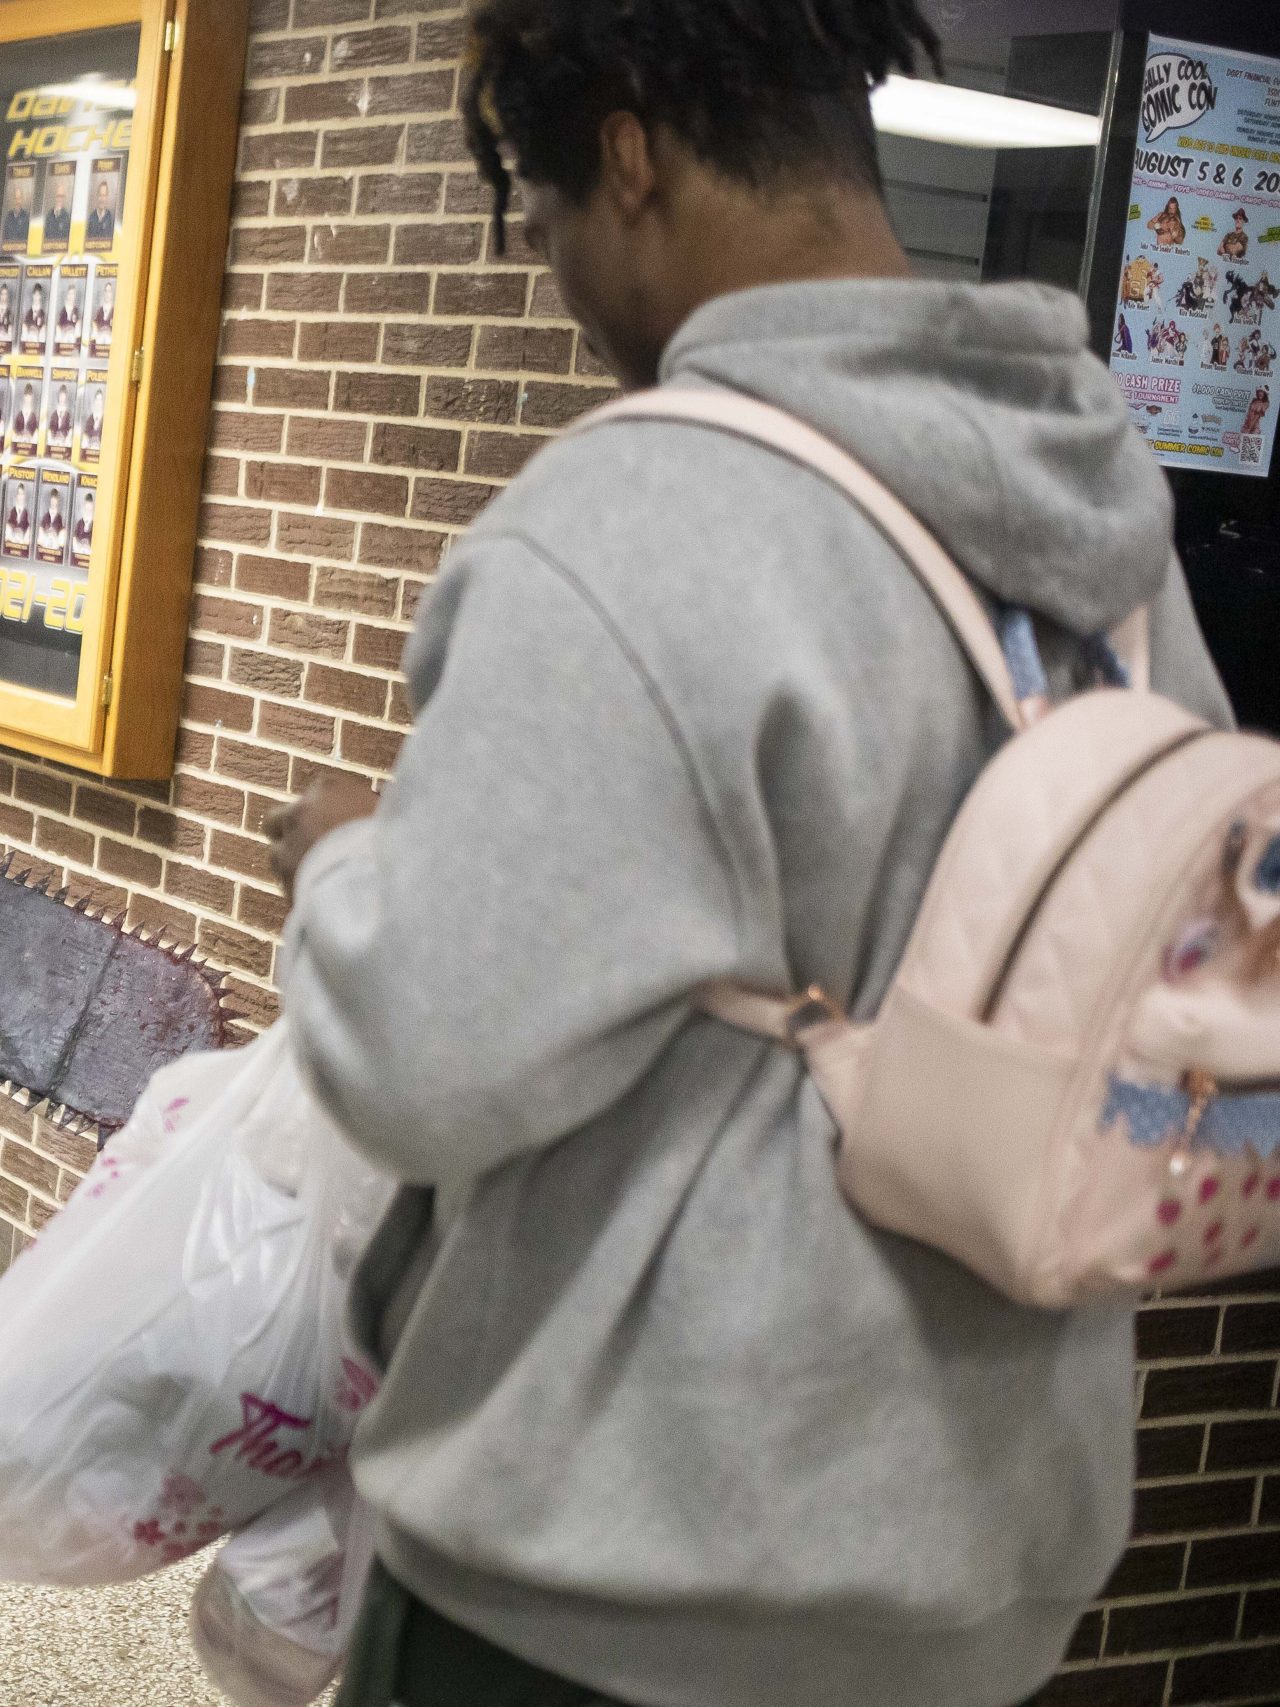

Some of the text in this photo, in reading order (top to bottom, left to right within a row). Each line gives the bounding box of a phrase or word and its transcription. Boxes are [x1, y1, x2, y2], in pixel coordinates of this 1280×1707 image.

[1177, 60, 1208, 80] COOL
[1142, 82, 1218, 132] COMIC CON
[1135, 148, 1280, 193] AUGUST 5 & 6 20
[1174, 184, 1190, 193] TOYS
[1125, 374, 1148, 389] CASH
[1151, 377, 1180, 393] PRIZE
[1134, 391, 1179, 404] TOURNAMENT
[1154, 440, 1186, 453] SUMMER
[1187, 444, 1210, 456] COMIC
[1210, 447, 1224, 457] CON
[9, 465, 35, 480] PASTOR
